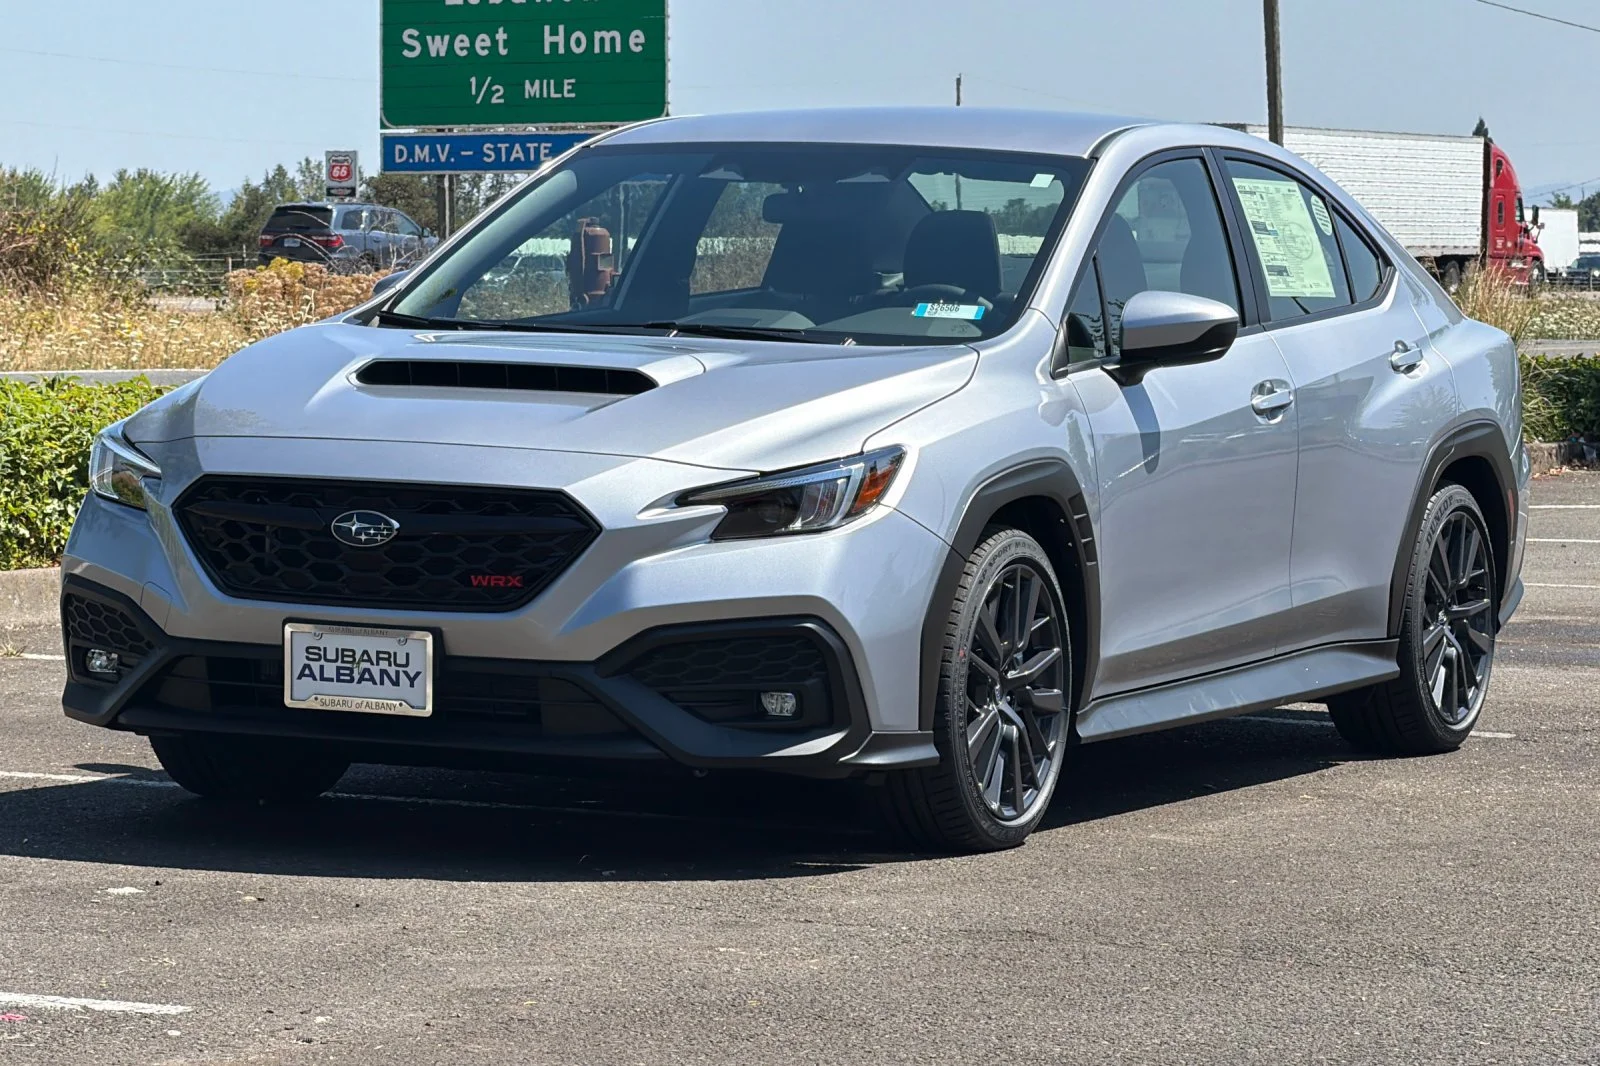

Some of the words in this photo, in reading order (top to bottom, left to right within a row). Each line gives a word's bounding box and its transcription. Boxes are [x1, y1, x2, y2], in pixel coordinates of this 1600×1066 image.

[402, 27, 509, 58] Sweet
[543, 24, 646, 55] Home
[524, 79, 576, 99] MILE
[482, 142, 553, 163] STATE
[332, 166, 348, 177] 66
[988, 543, 1013, 568] SPORT
[470, 575, 523, 587] WRX
[305, 645, 410, 668] SUBARU
[296, 663, 423, 688] ALBANY
[319, 698, 353, 708] SUBARU
[355, 701, 364, 709] of
[365, 702, 398, 712] ALBANY
